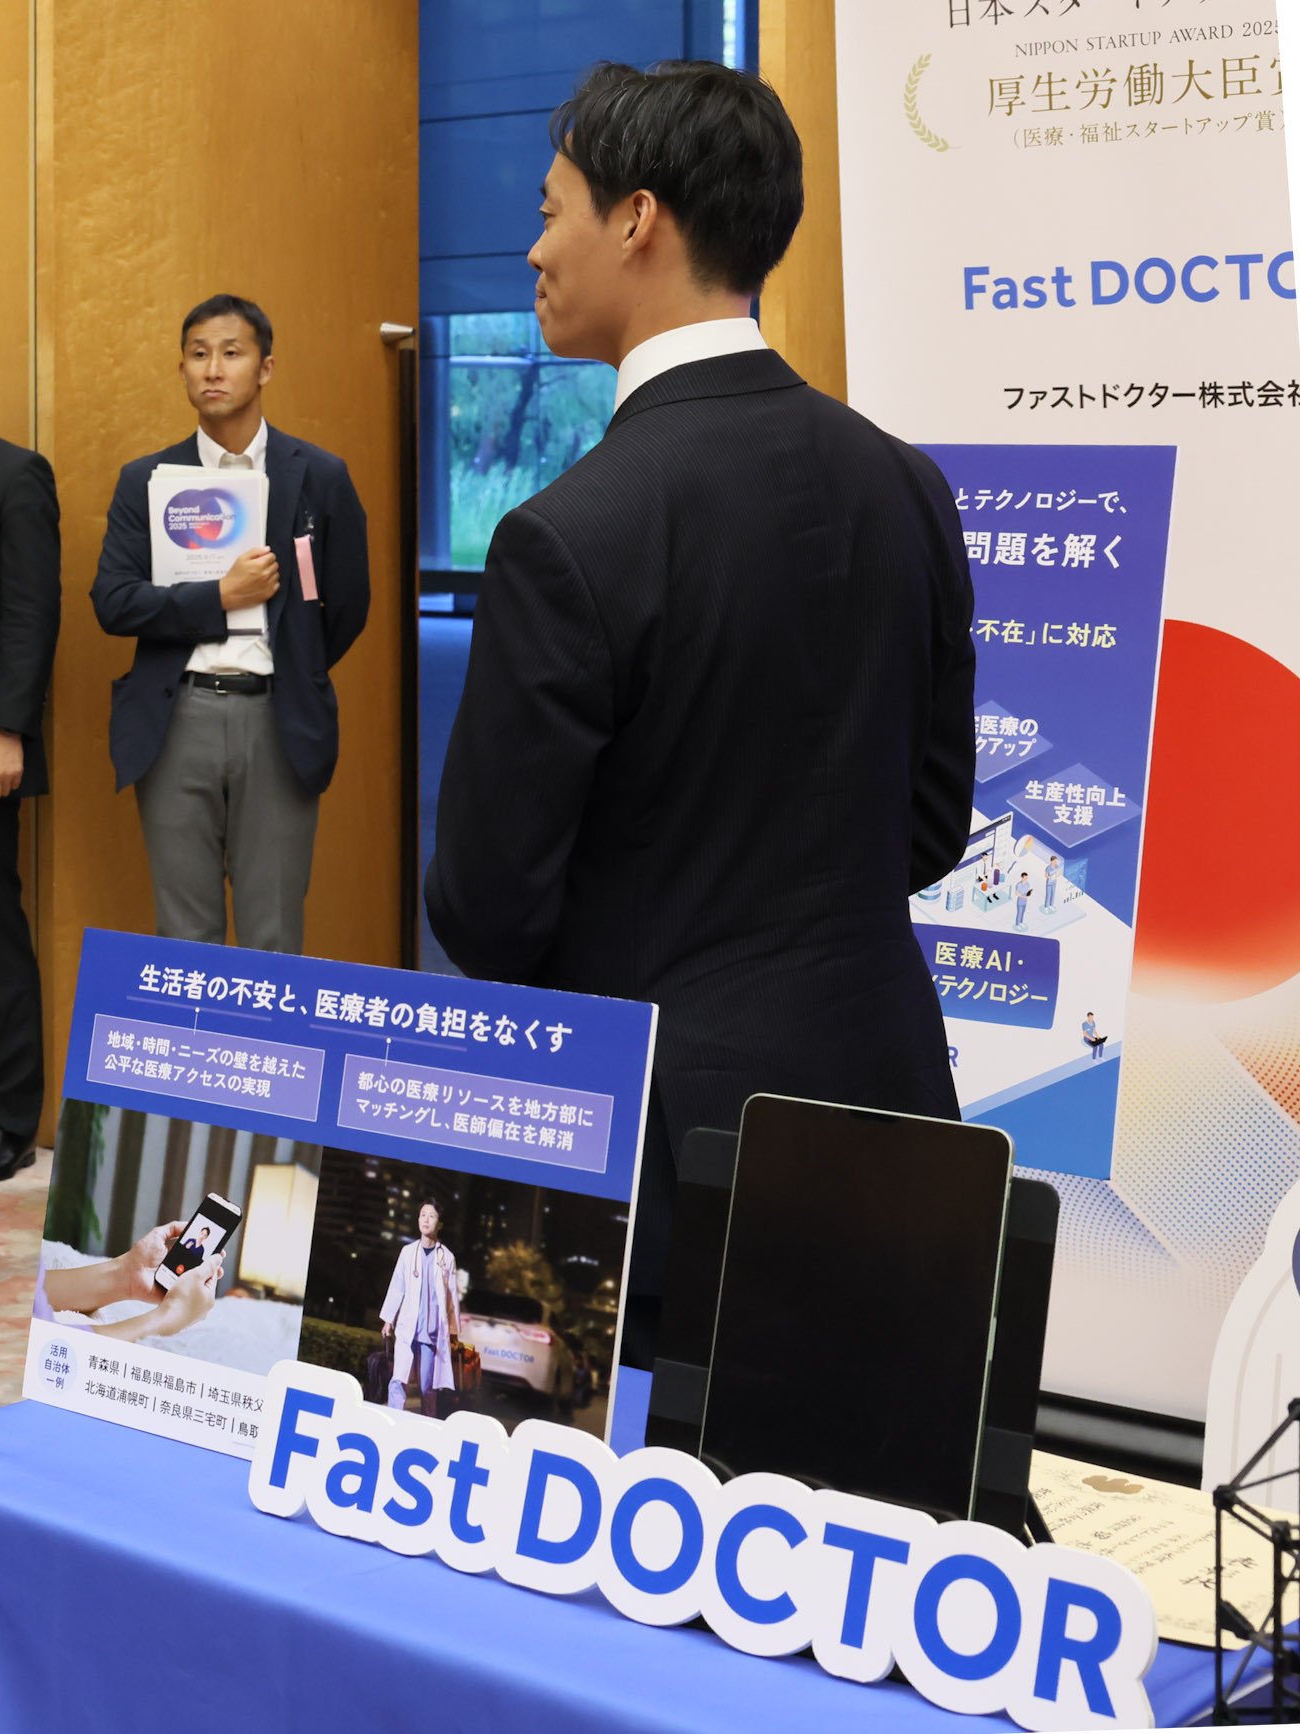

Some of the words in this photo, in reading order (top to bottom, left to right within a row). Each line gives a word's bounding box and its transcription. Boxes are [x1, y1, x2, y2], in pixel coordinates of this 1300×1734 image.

[1015, 38, 1079, 57] NIPPON
[1087, 30, 1162, 51] STARTUP
[1169, 24, 1233, 44] AWARD
[964, 266, 1076, 310] Fast
[962, 531, 1124, 569] 問題を解く
[1024, 780, 1126, 807] 生産性向上
[1053, 804, 1094, 826] 支援
[138, 964, 572, 1053] 生活者の不安と、医療者の負担をなくす
[931, 974, 1048, 1005] テクノロジー
[107, 1030, 306, 1079] 地域・時間・ニーズの壁を越えた
[104, 1053, 271, 1098] 公平な医療アクセスの実現
[357, 1071, 594, 1127] 都心の医療リソースを地方部に
[356, 1098, 574, 1151] マッチングし、医師偏在を解消
[44, 1358, 70, 1375] 自治体
[50, 1344, 68, 1359] 活用
[46, 1376, 65, 1390] 一例
[269, 1387, 489, 1545] Fast
[515, 1449, 1122, 1718] DOCTOR
